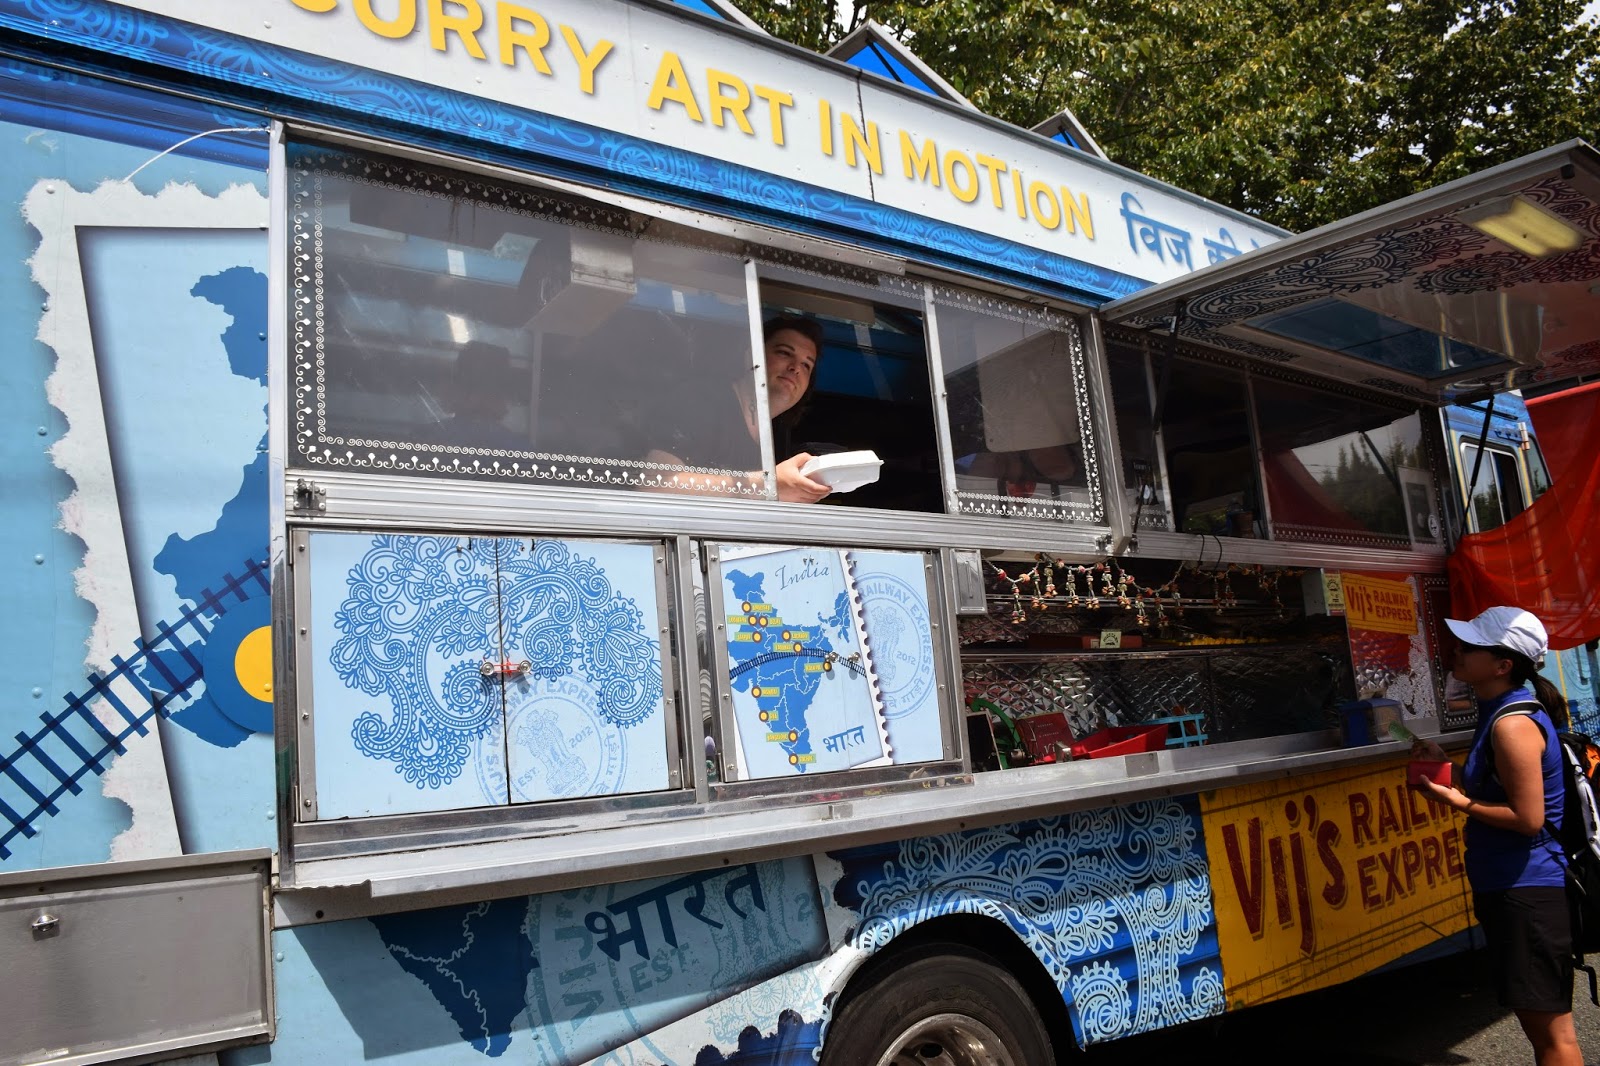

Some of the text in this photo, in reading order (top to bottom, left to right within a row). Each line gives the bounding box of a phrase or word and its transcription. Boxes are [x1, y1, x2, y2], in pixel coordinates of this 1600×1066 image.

[287, 0, 1095, 241] URRY ART IN MOTION
[1119, 191, 1194, 273] विज
[774, 561, 829, 591] India
[1346, 585, 1373, 621] Vij's
[1373, 590, 1409, 608] RAILWAY
[1375, 605, 1414, 621] EXPRESS
[859, 582, 932, 676] RAILWAY EXPRESS
[896, 651, 917, 666] 2012
[569, 726, 594, 749] 2012
[822, 725, 866, 753] भारत
[517, 766, 541, 788] EST.
[1348, 784, 1461, 846] RAILW
[1221, 794, 1348, 959] Vij's
[1356, 828, 1466, 912] EXPRE
[584, 863, 767, 962] भारत
